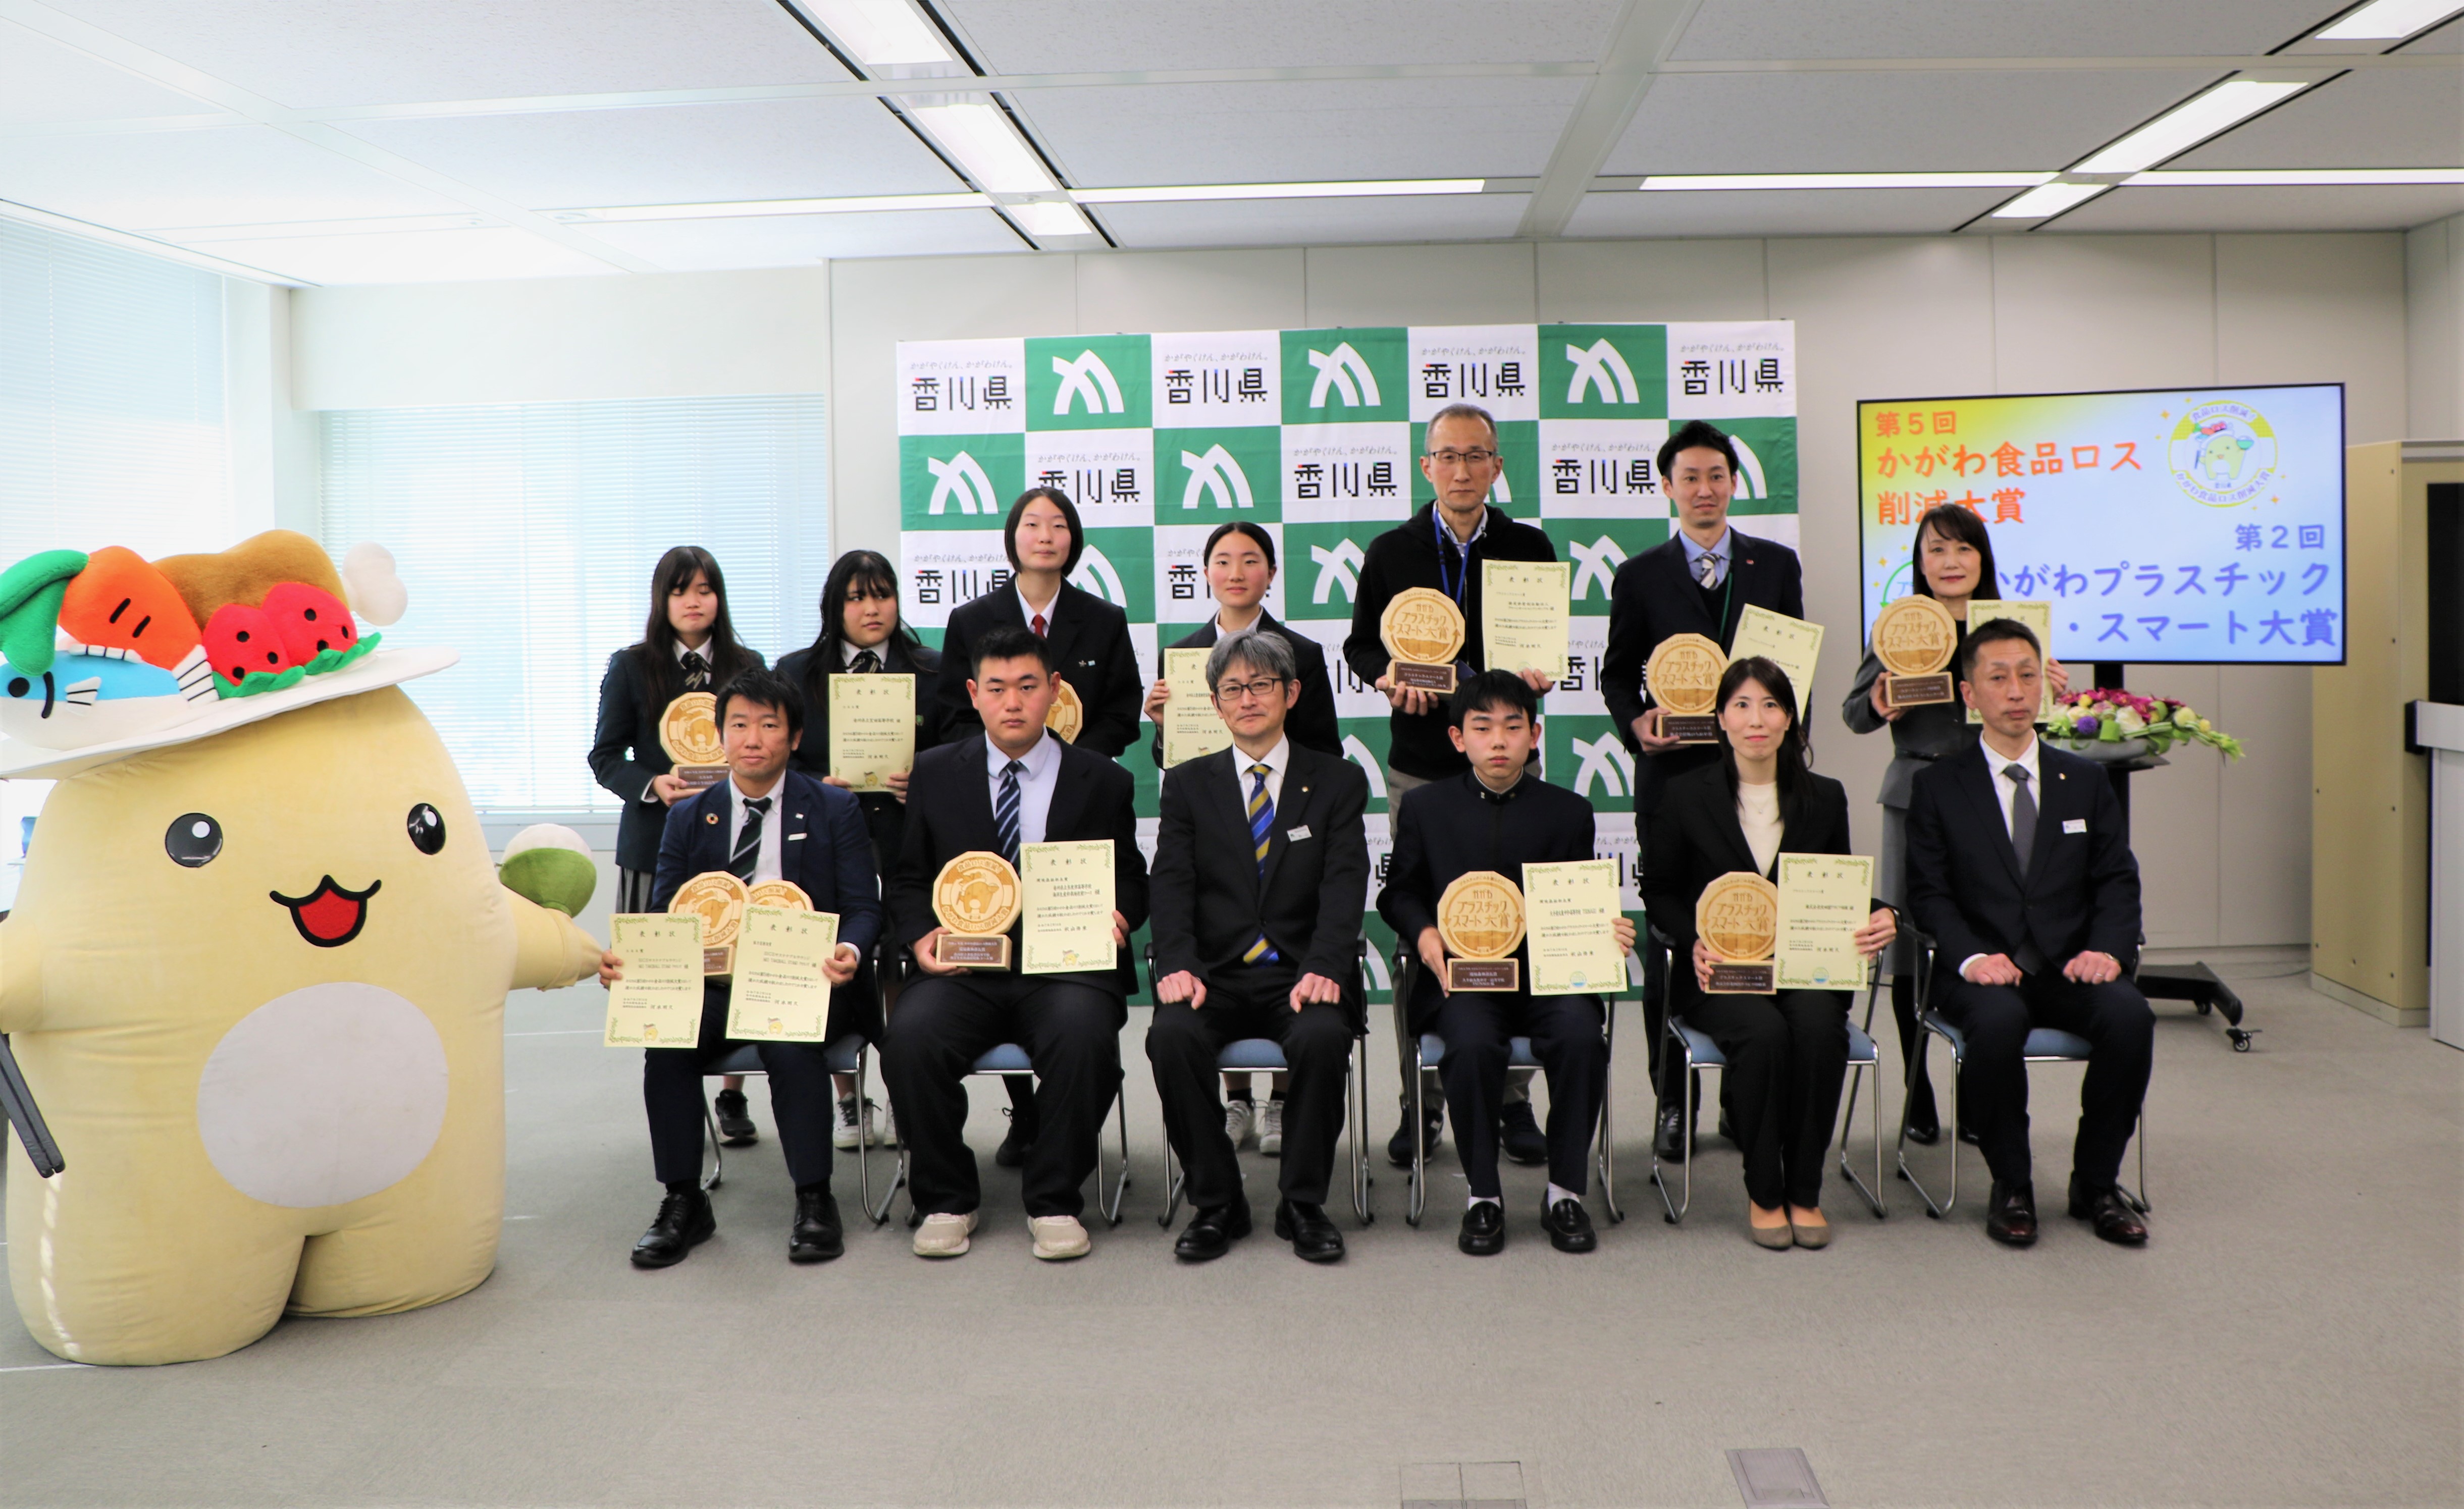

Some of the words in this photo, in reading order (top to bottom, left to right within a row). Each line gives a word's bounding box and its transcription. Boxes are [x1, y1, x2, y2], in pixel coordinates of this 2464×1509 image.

[912, 375, 1012, 411] 香川県
[1165, 368, 1268, 404] 香川県
[1422, 362, 1526, 398] 香川県
[1681, 358, 1784, 396] 香川県
[1876, 410, 1957, 437] 第5回
[1552, 459, 1656, 494] 香川県
[1877, 441, 2142, 477] かがわ食品ロス
[1294, 462, 1397, 499] 香川県
[2235, 523, 2324, 551] 第2回
[1401, 612, 1447, 626] プラスチック
[1665, 661, 1711, 673] プラスチック
[1457, 900, 1507, 913] プラスチック
[1716, 903, 1767, 916] プラスチック
